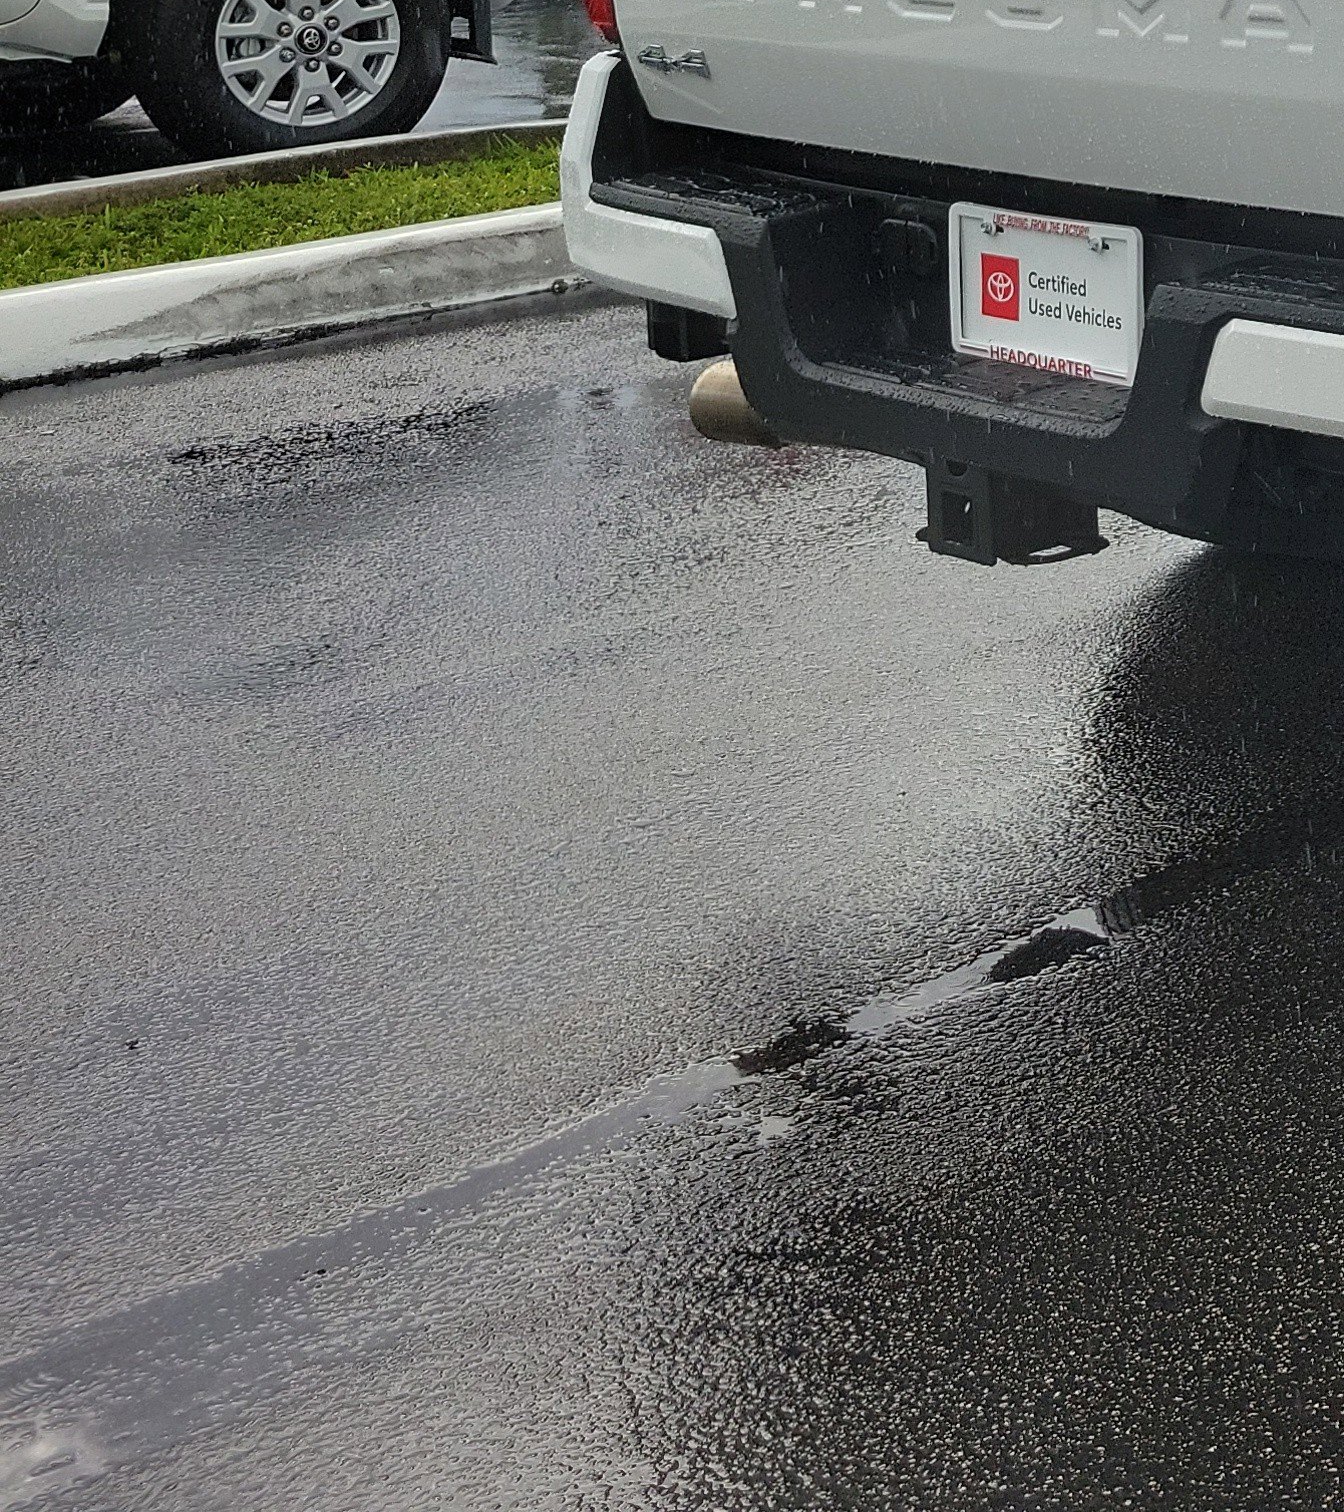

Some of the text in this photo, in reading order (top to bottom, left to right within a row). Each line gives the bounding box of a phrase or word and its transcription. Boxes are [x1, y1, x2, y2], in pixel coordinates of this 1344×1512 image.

[1028, 271, 1087, 297] Certified
[1028, 297, 1122, 330] Used Vehicles
[990, 344, 1093, 378] HEADQUARTER
